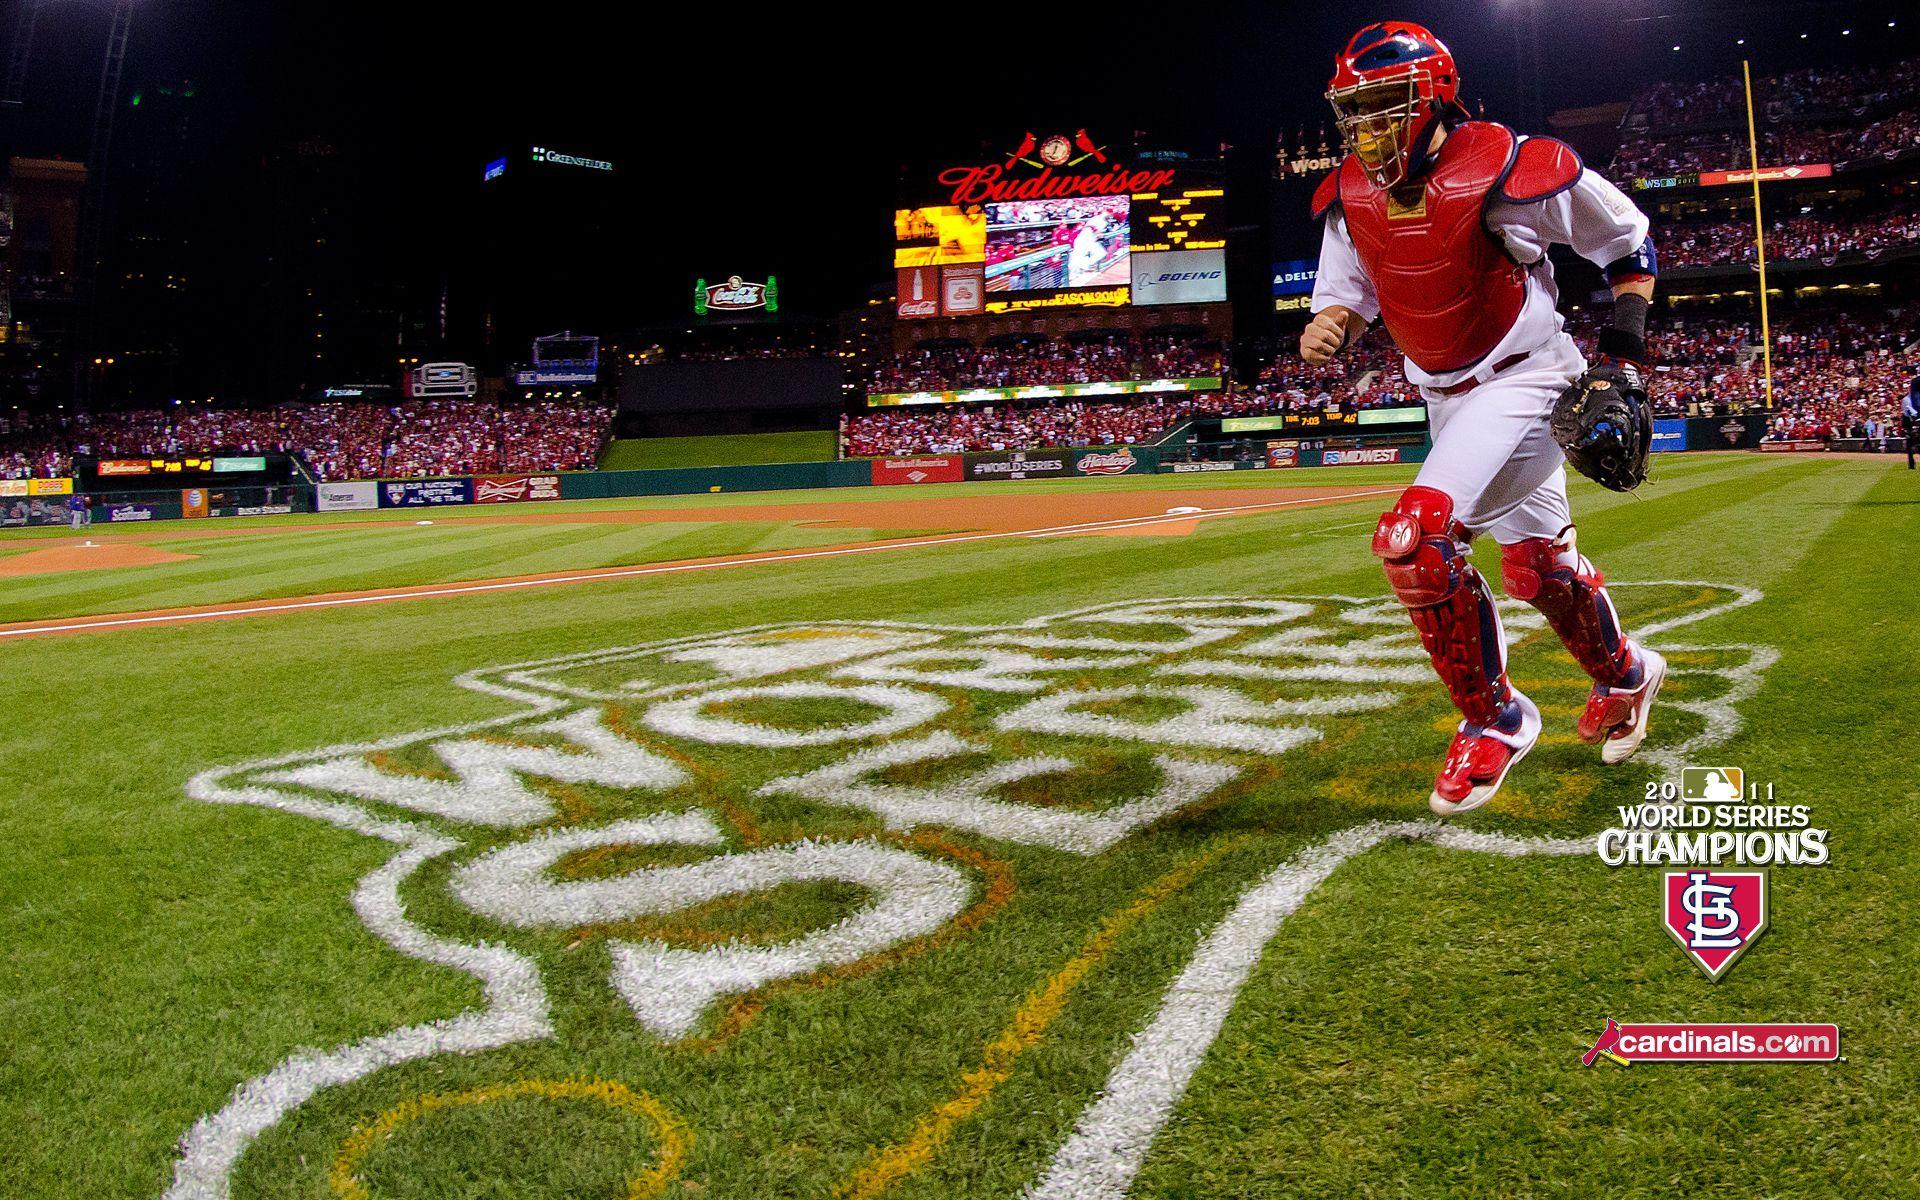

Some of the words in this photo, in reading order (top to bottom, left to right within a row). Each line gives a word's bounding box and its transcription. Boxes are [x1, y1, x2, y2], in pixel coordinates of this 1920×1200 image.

[546, 150, 613, 170] GREENSFELDER
[1290, 155, 1344, 174] WORL
[937, 163, 1175, 204] Budweiser
[1158, 270, 1222, 283] BOEING
[1301, 416, 1320, 426] 7:03
[1341, 448, 1398, 463] MIDWEST
[1022, 460, 1063, 471] SERIES
[424, 481, 464, 489] NATIONAL
[252, 600, 1316, 827] WORLD
